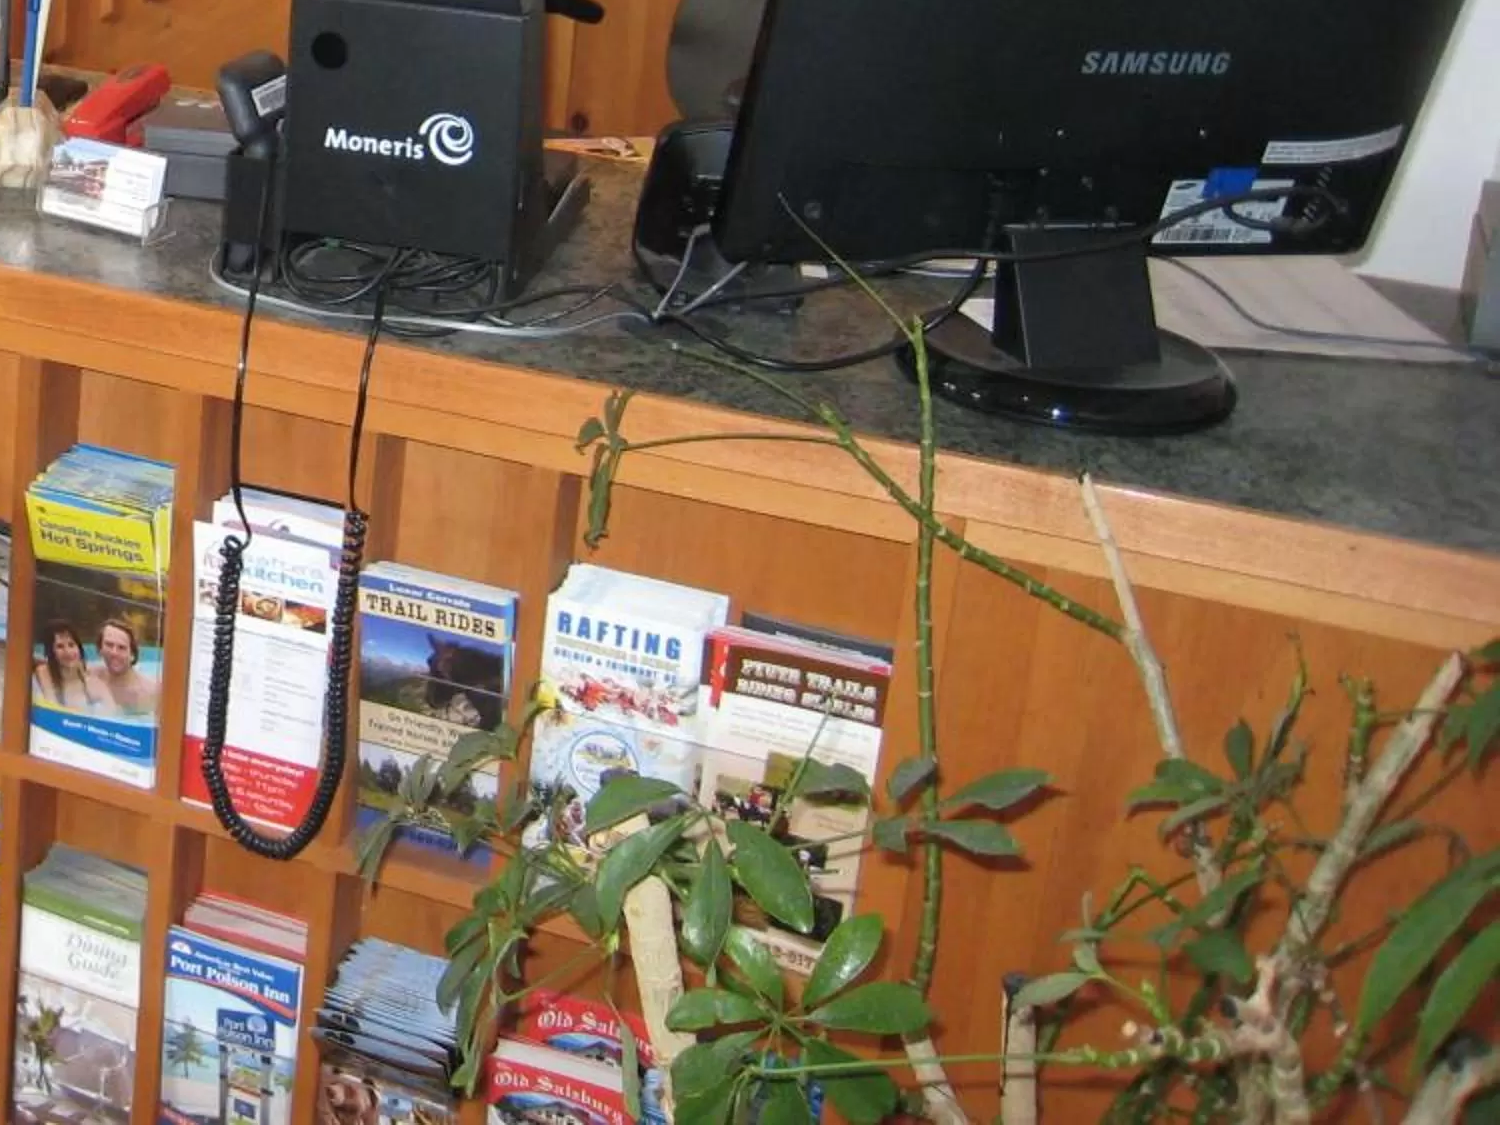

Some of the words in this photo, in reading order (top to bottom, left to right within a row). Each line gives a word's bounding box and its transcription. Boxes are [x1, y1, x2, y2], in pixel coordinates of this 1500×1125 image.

[1081, 51, 1231, 75] SAMSUNG
[324, 127, 425, 160] Moneris
[40, 528, 71, 547] Hot
[75, 537, 144, 563] Springs
[366, 593, 428, 622] TRAIL
[435, 608, 496, 639] RIDES
[557, 610, 682, 661] RAFTING
[171, 955, 203, 976] Port
[263, 984, 291, 1004] Inn
[537, 1007, 574, 1029] Old
[493, 1071, 530, 1088] Old
